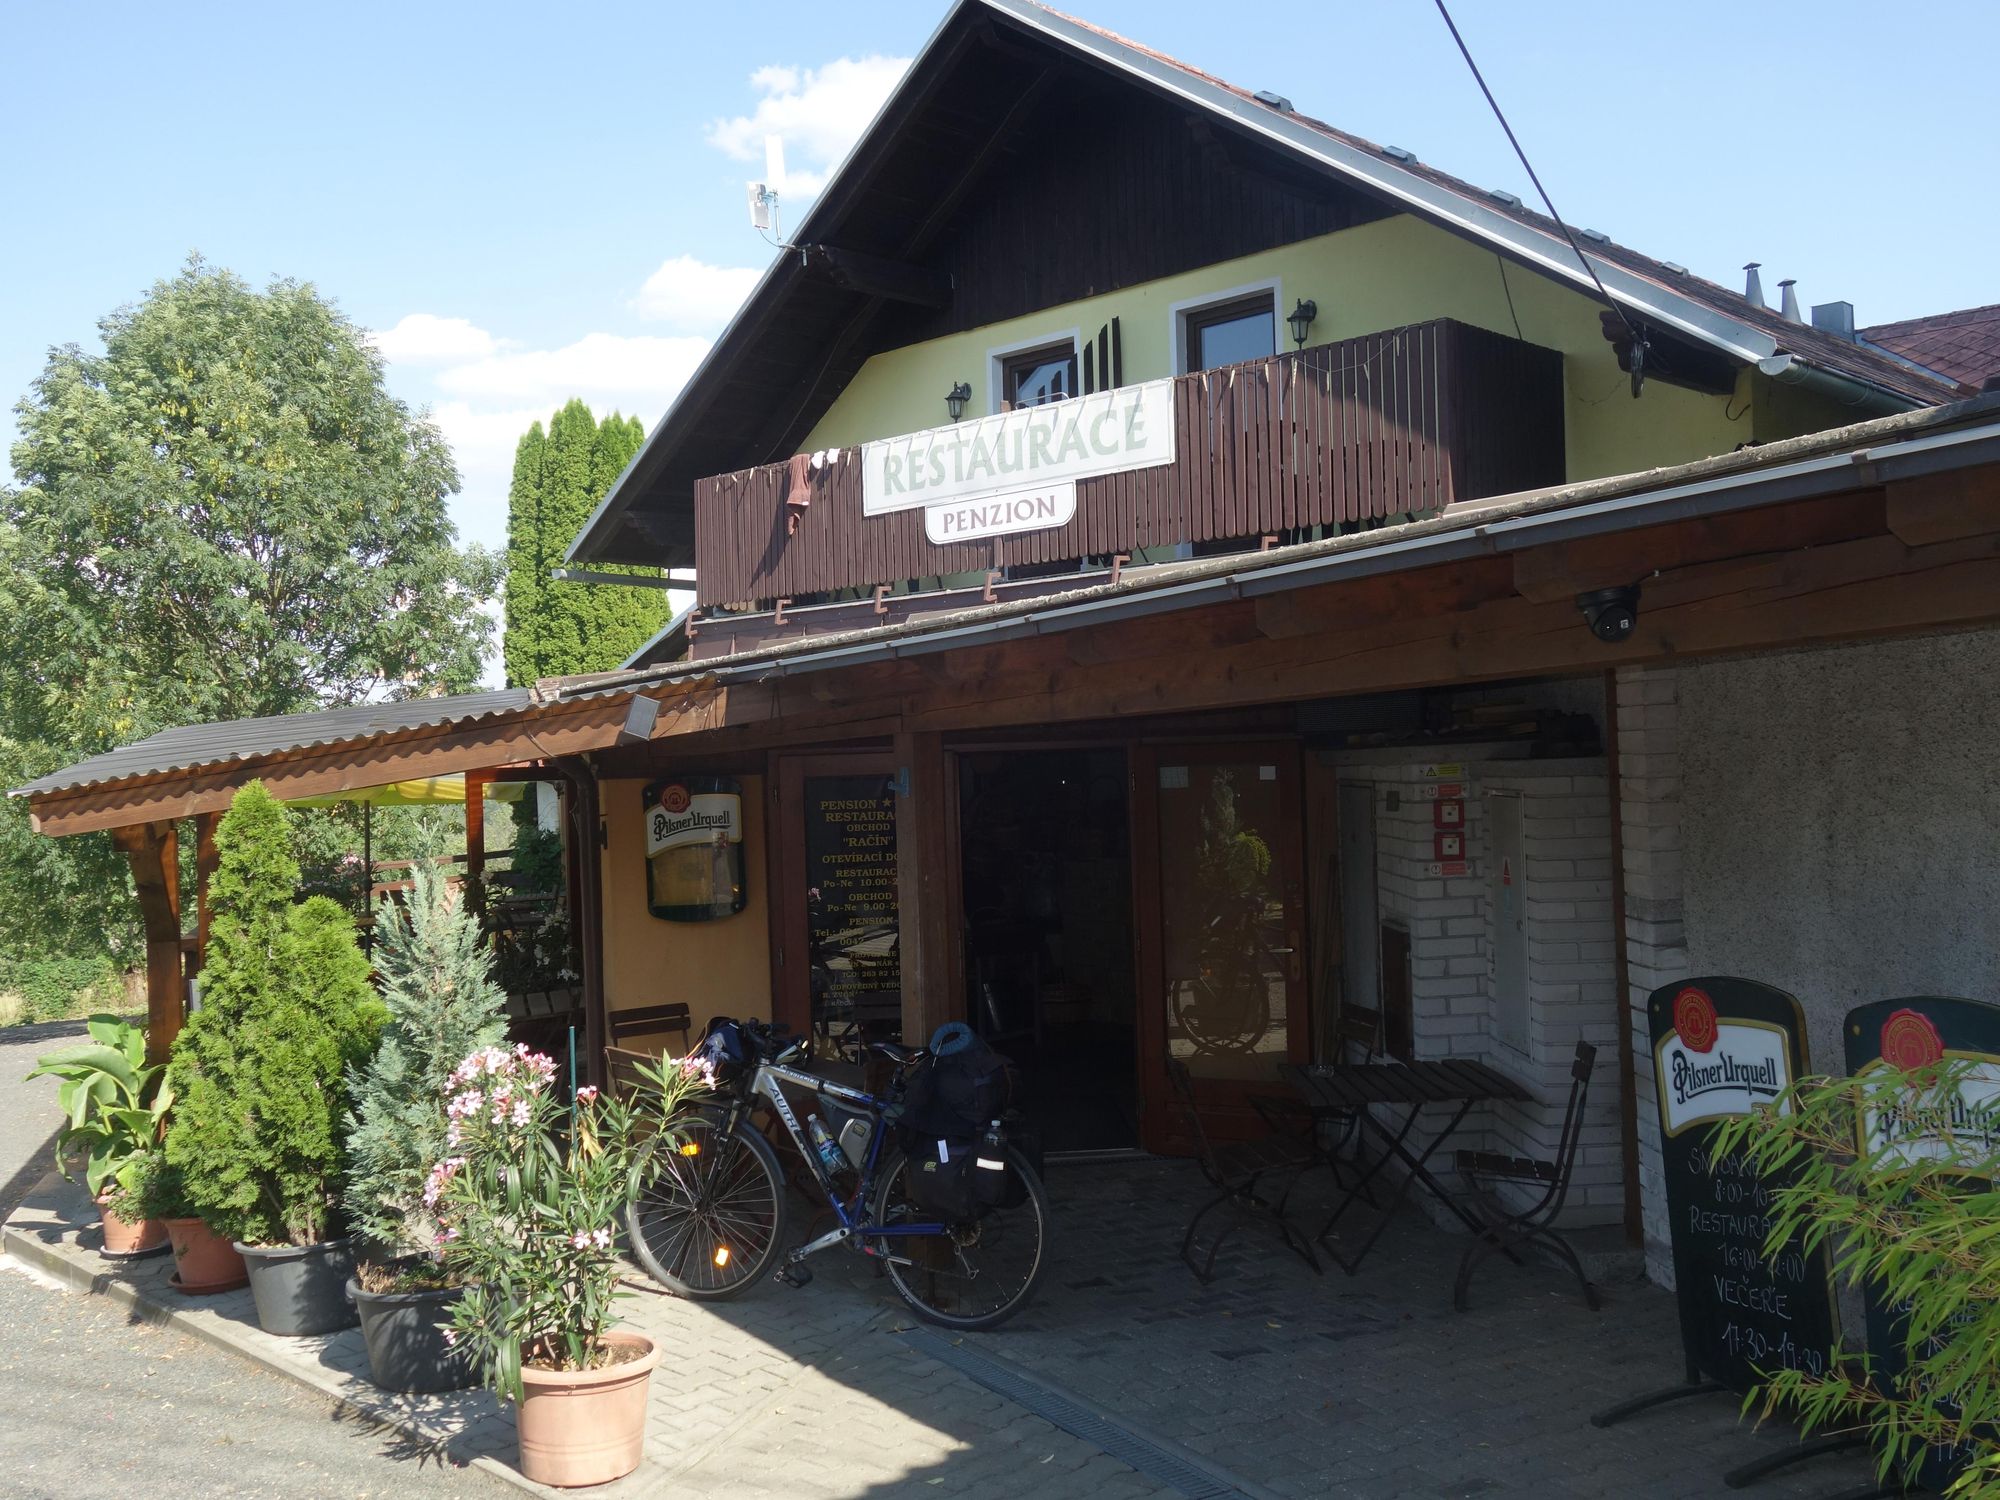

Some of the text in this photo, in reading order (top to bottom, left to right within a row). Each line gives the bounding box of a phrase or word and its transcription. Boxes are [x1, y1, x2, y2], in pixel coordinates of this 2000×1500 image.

[883, 405, 1149, 496] RESTAURACE
[943, 495, 1056, 534] PENZION
[820, 799, 877, 810] PENSION
[825, 811, 896, 822] RESTAURA
[653, 810, 731, 842] Pilsner Urquell
[846, 823, 890, 832] OBCHOD
[848, 892, 893, 902] OBCHOD
[1672, 1049, 1778, 1105] Pilsner Urquell
[769, 1087, 803, 1136] AUTH
